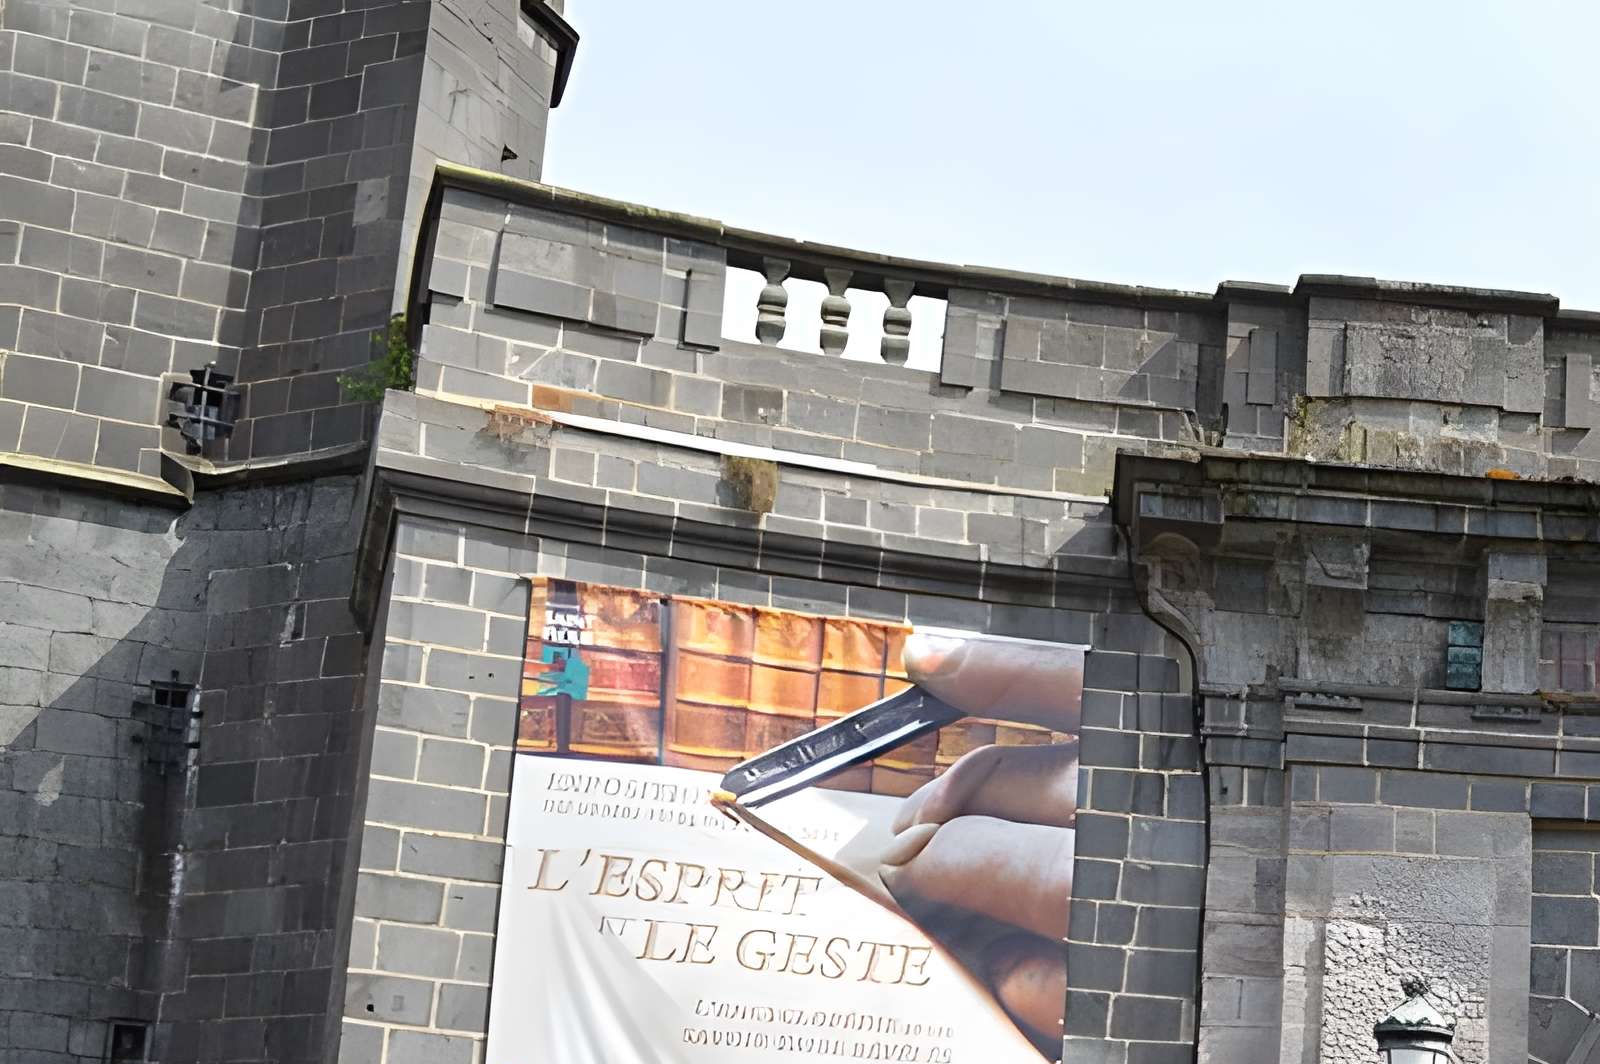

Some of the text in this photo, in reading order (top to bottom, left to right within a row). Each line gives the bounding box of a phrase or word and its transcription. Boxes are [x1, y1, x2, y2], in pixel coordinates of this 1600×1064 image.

[527, 849, 822, 916] L'ESPRIT
[636, 918, 719, 965] LE
[736, 929, 932, 987] GESTE
